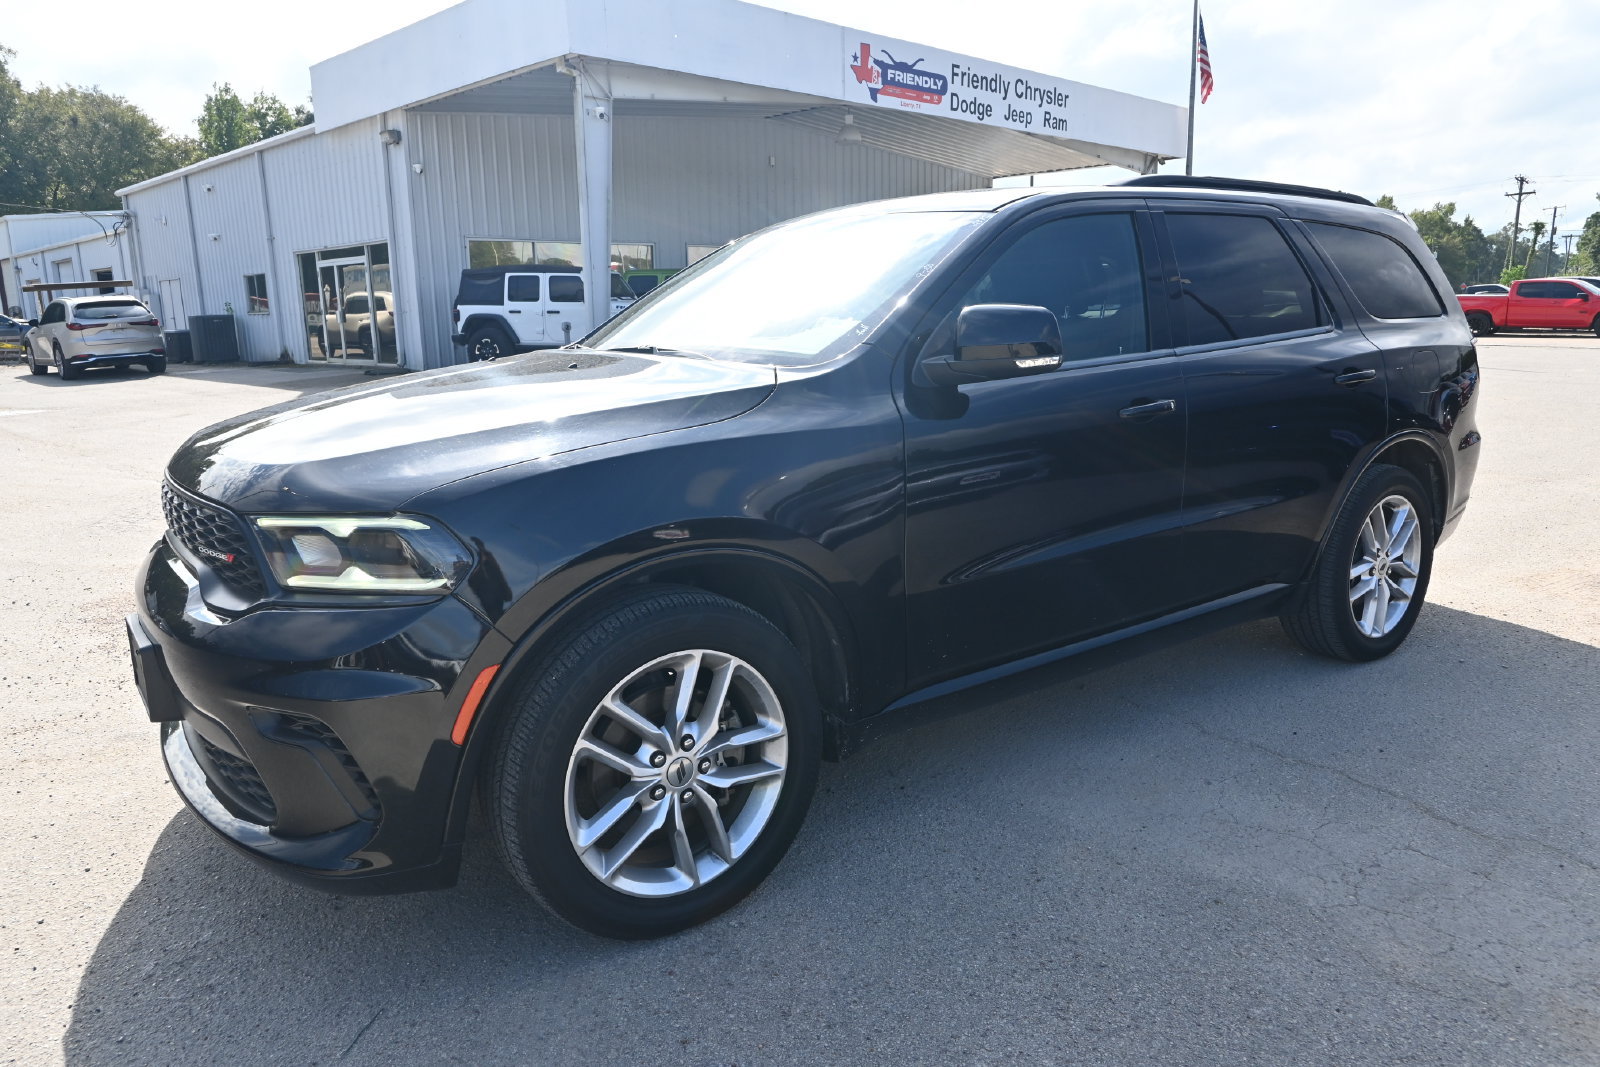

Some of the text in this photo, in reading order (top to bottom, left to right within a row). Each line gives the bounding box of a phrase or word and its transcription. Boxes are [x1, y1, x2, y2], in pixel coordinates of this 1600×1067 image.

[887, 68, 944, 91] FRIENDLY
[951, 63, 1070, 109] Friendly Chrysler
[950, 92, 1068, 132] Dodge Jeep Ram
[198, 546, 228, 561] DODGE
